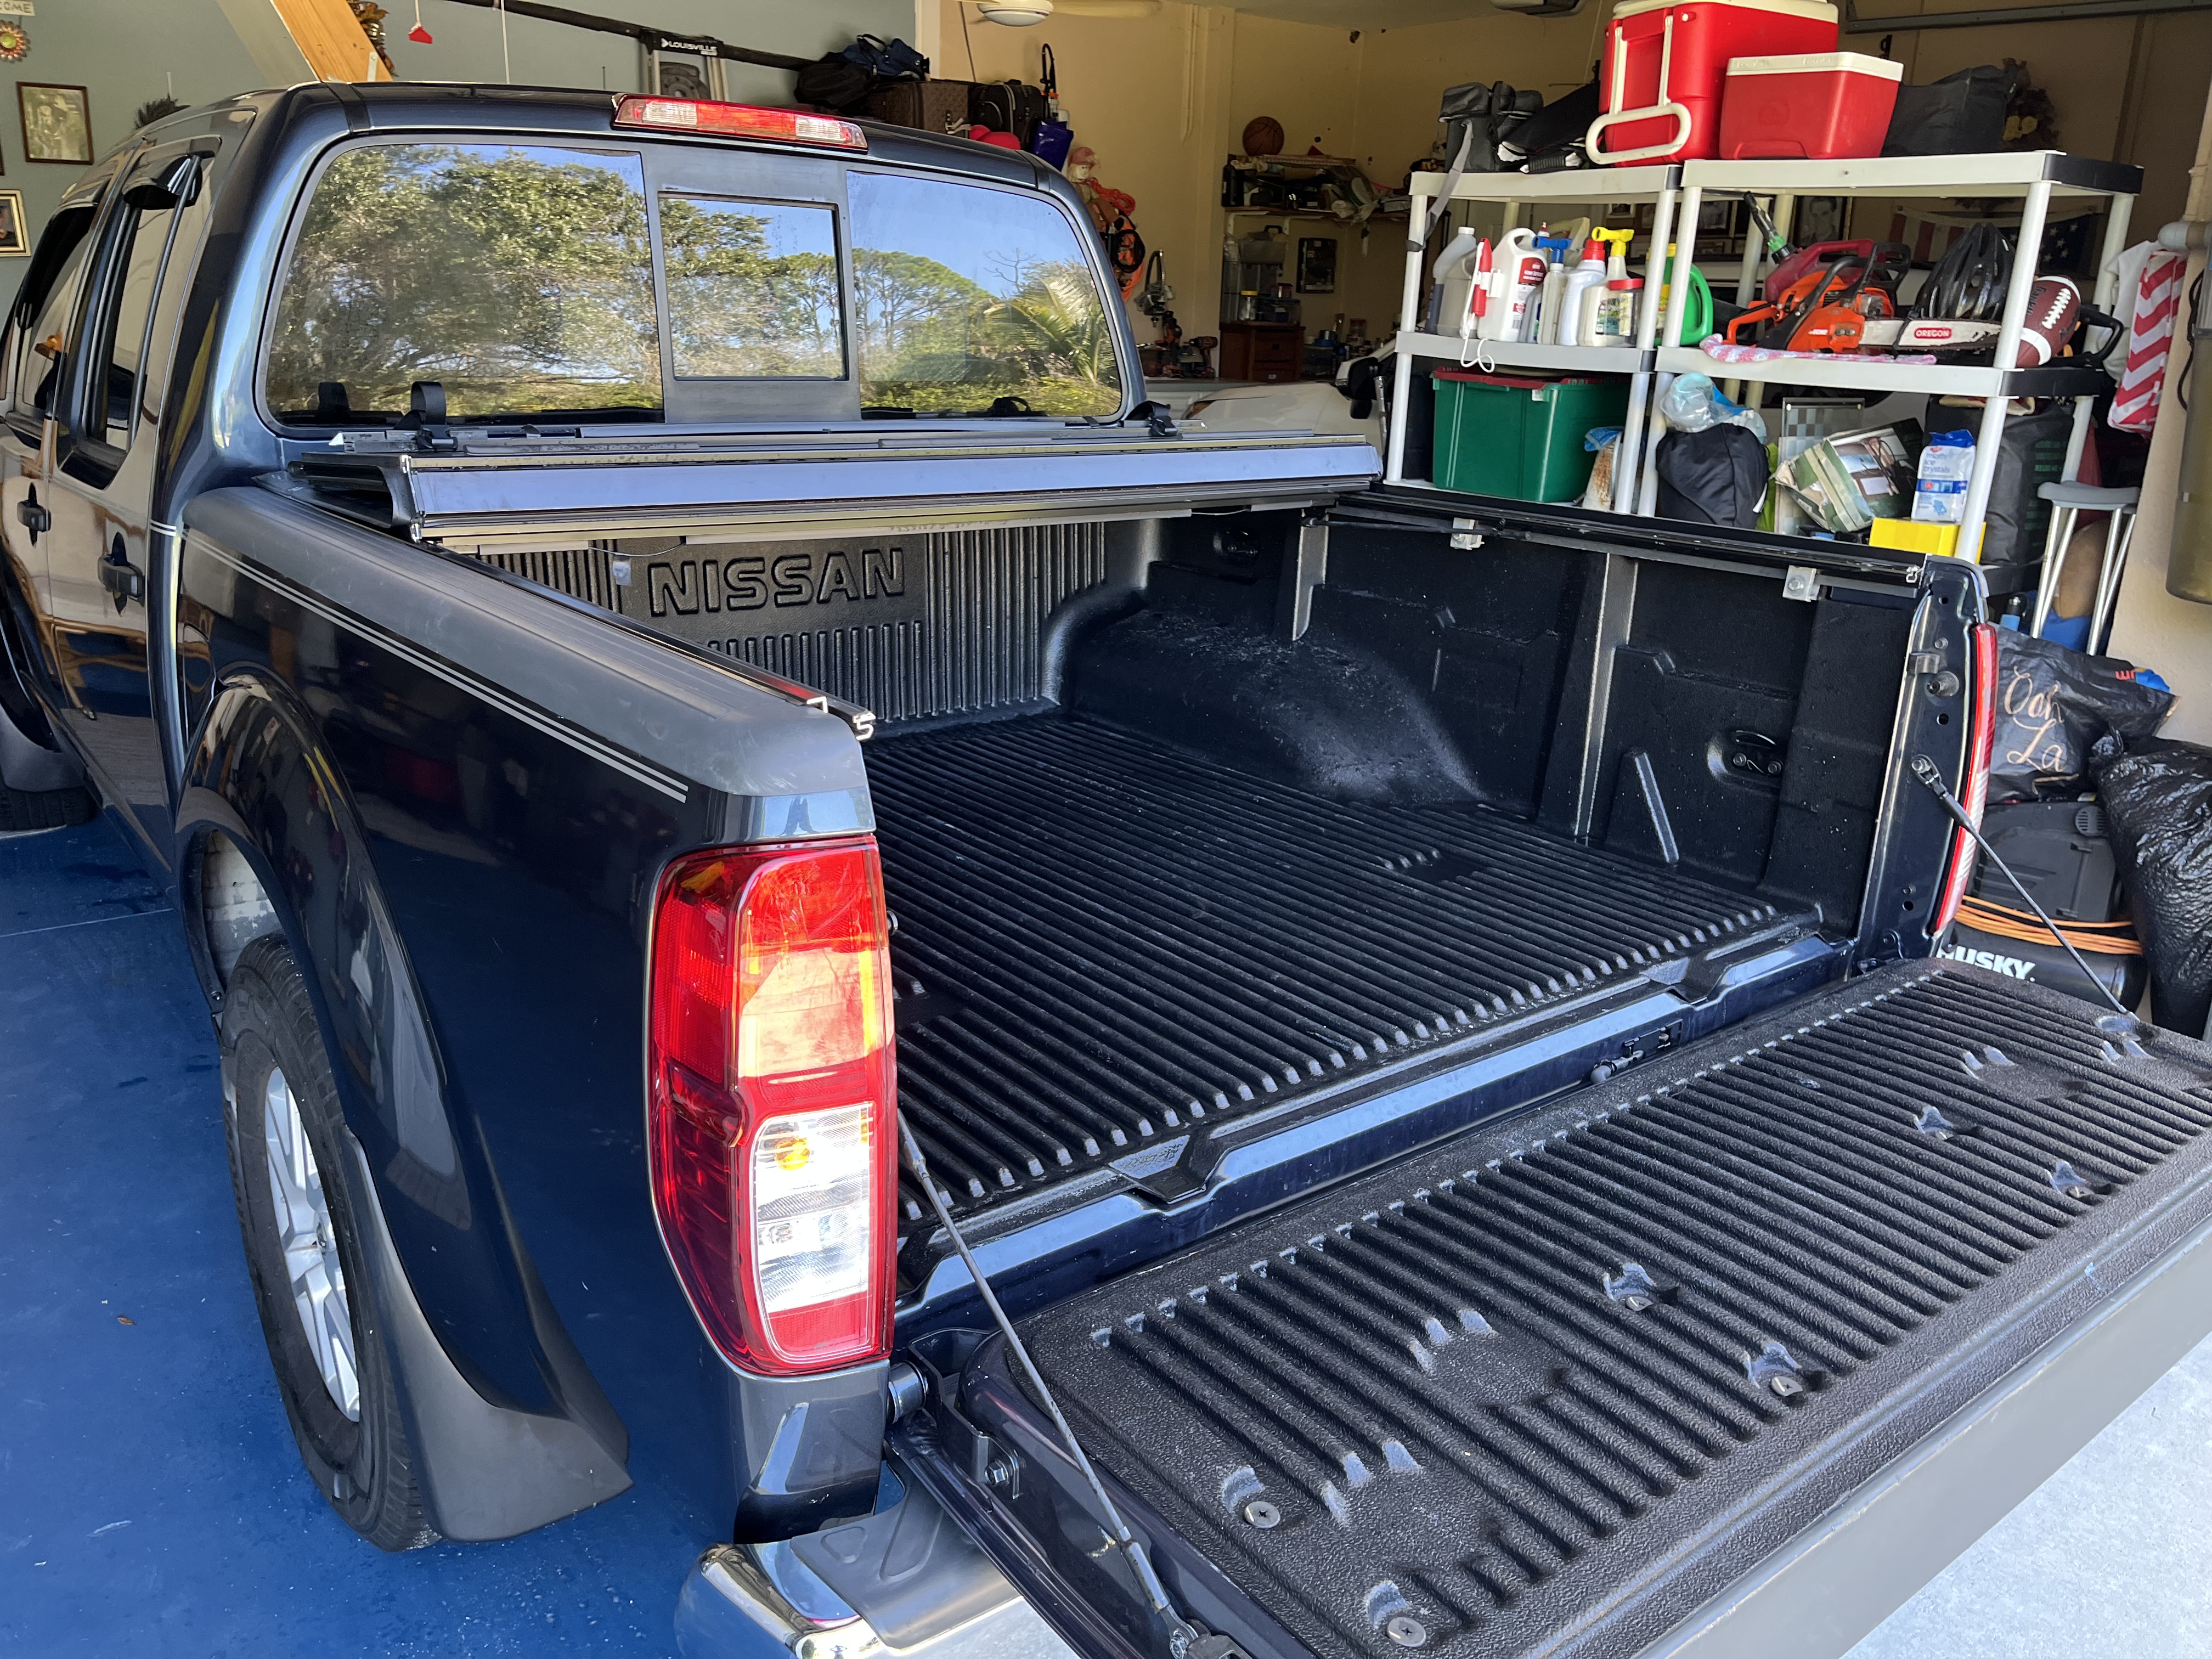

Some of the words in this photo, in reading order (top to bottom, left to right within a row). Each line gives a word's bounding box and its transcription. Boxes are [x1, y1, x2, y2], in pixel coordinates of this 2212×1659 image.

[0, 2, 32, 14] OME
[668, 41, 717, 52] LOUISVILLE
[647, 548, 905, 617] NISSAN
[2006, 718, 2072, 772] La
